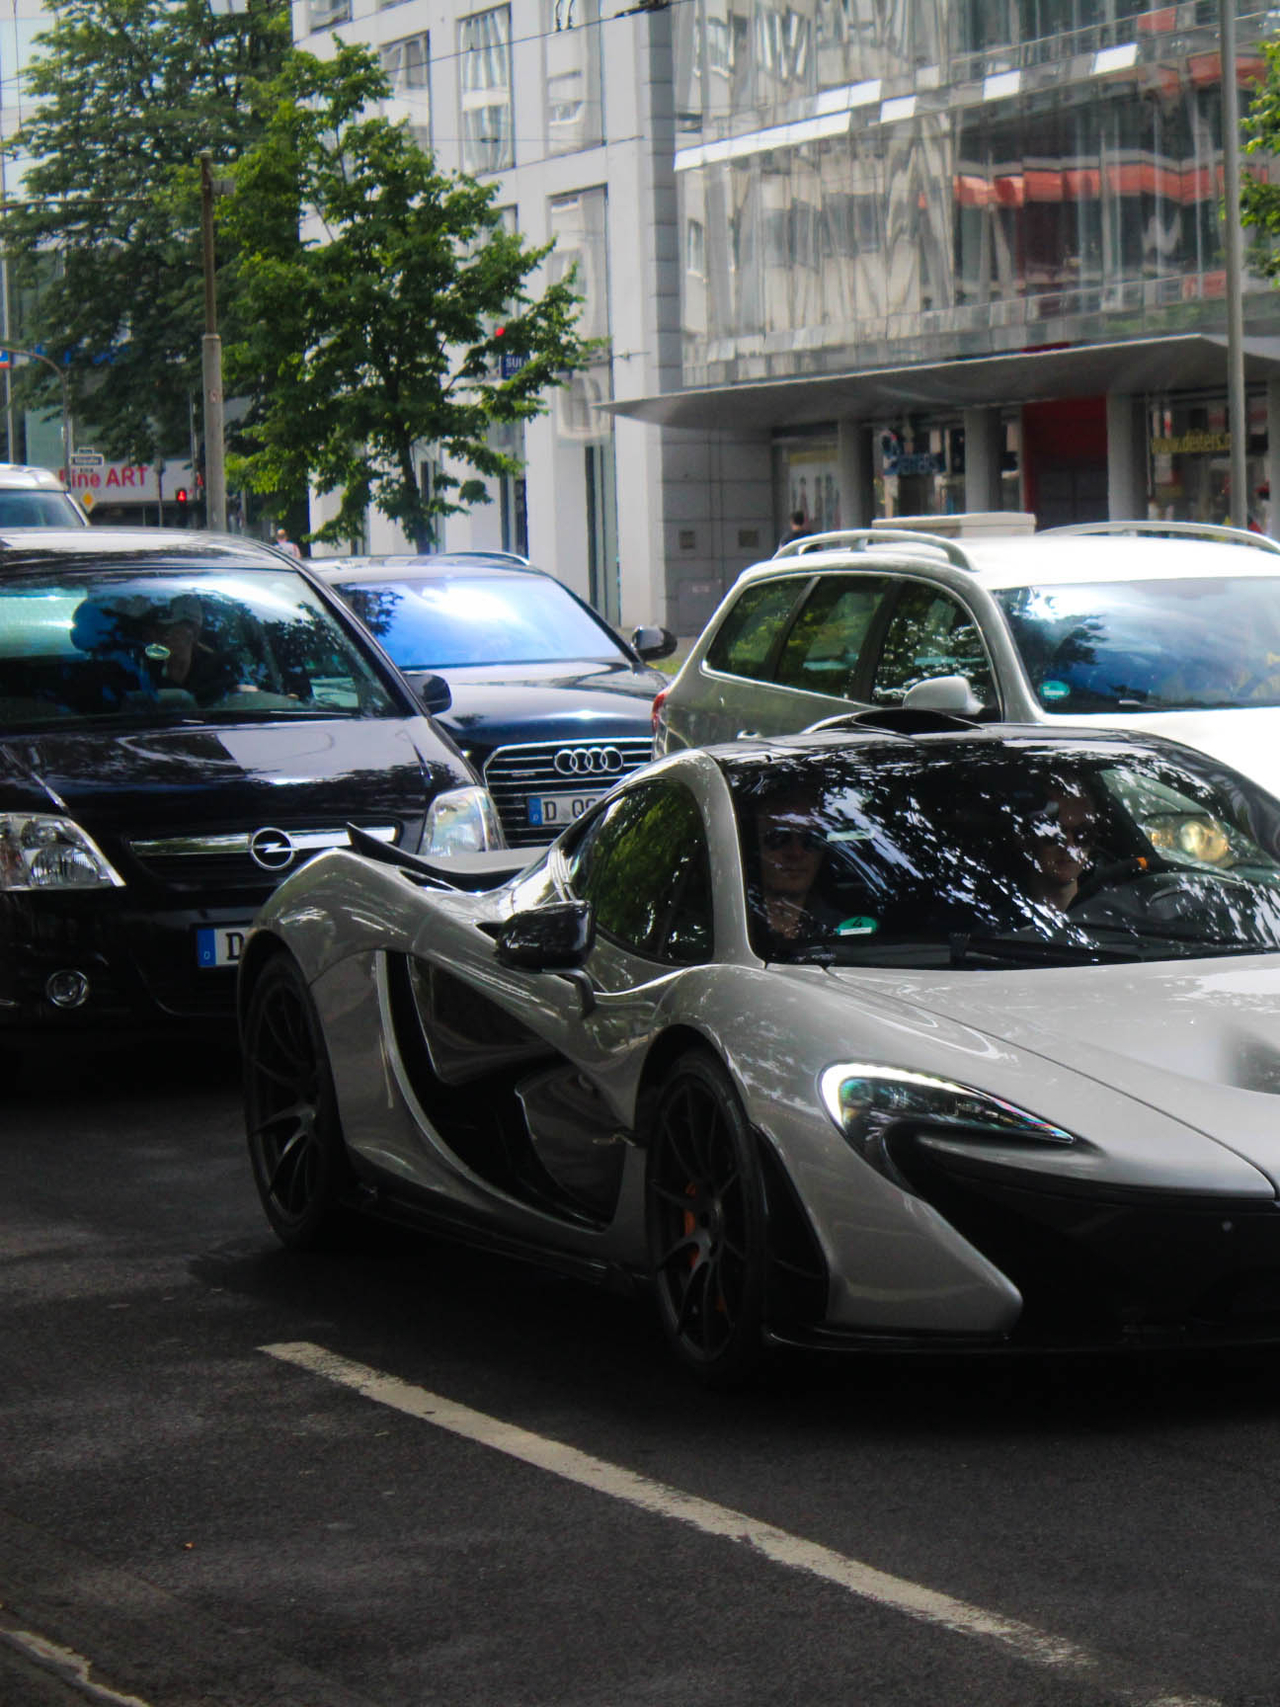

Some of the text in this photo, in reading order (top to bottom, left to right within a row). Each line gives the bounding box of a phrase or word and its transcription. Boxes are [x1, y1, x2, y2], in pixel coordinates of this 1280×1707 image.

[105, 466, 149, 488] ART
[543, 801, 558, 821] D
[226, 931, 245, 961] D
